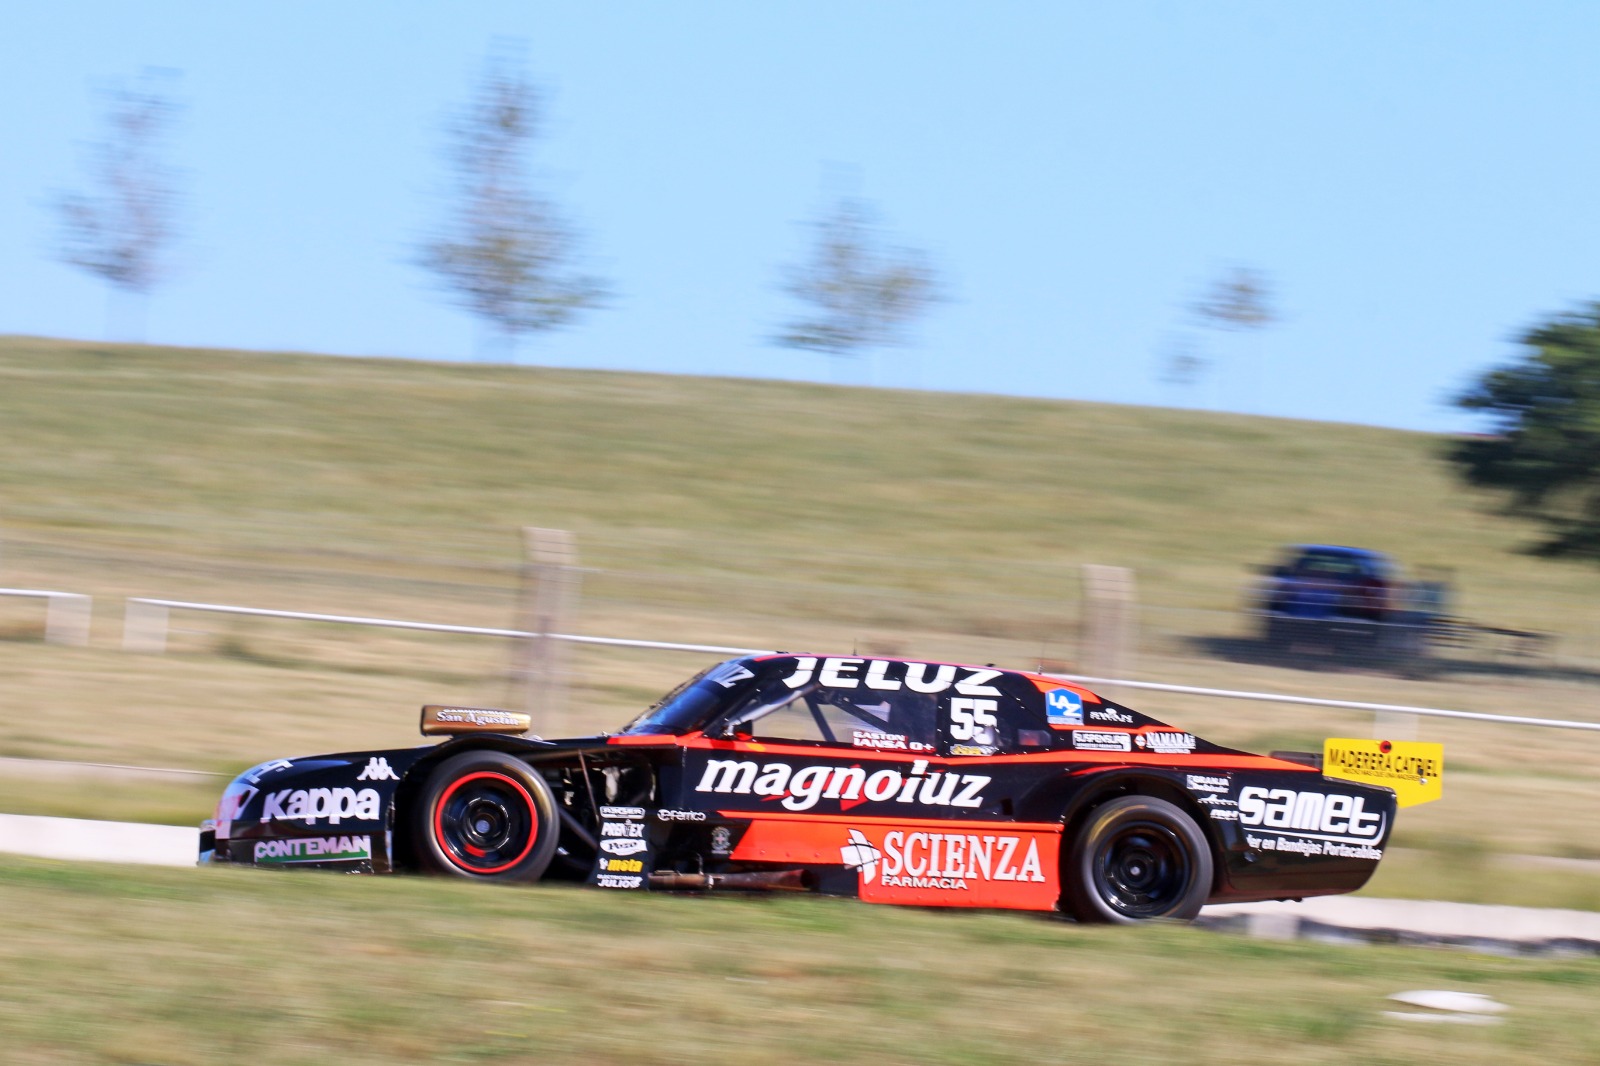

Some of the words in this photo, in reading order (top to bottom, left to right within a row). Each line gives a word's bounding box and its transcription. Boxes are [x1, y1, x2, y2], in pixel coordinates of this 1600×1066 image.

[783, 657, 1003, 697] JELUZ
[437, 711, 463, 722] San
[950, 697, 998, 744] 55
[1146, 732, 1190, 748] NAMARA
[1328, 748, 1391, 771] MADERERA
[1395, 755, 1438, 778] CATRIEL
[1239, 786, 1381, 836] samet
[254, 835, 370, 859] CONTEMAN
[1262, 838, 1276, 850] en
[883, 830, 1046, 883] SCIENZA
[598, 879, 631, 888] JULIO
[881, 875, 968, 890] FARMACIA
